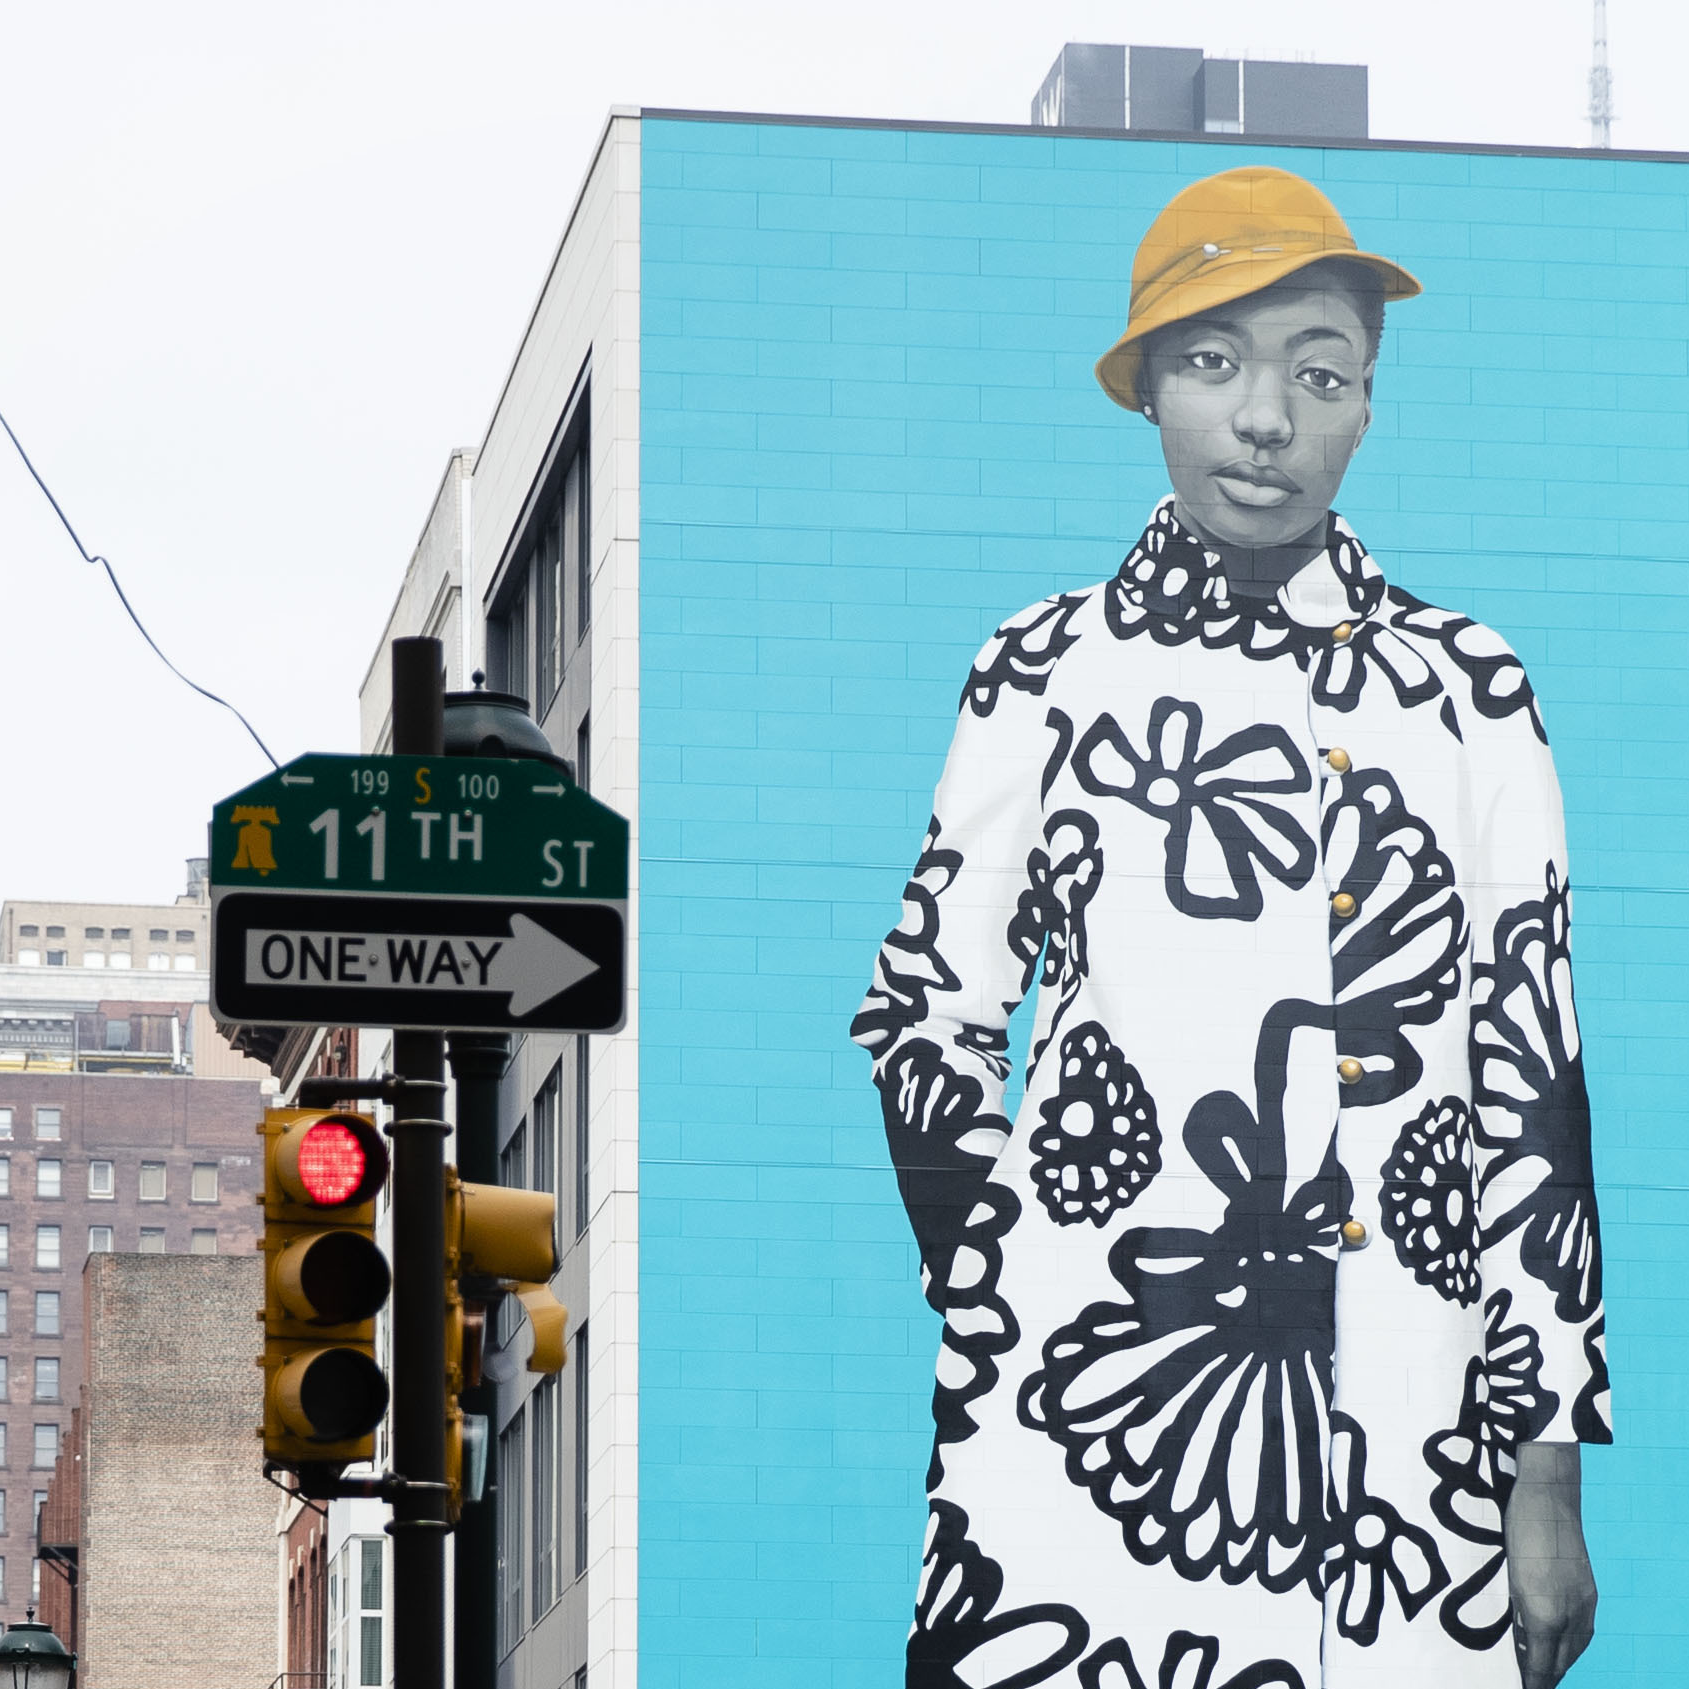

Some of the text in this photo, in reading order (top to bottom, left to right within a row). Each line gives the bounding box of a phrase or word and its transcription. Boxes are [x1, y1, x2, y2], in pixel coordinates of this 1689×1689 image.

[351, 767, 500, 804] 199 S 100
[309, 807, 595, 888] 11TH ST
[261, 934, 503, 986] ONE WAY
